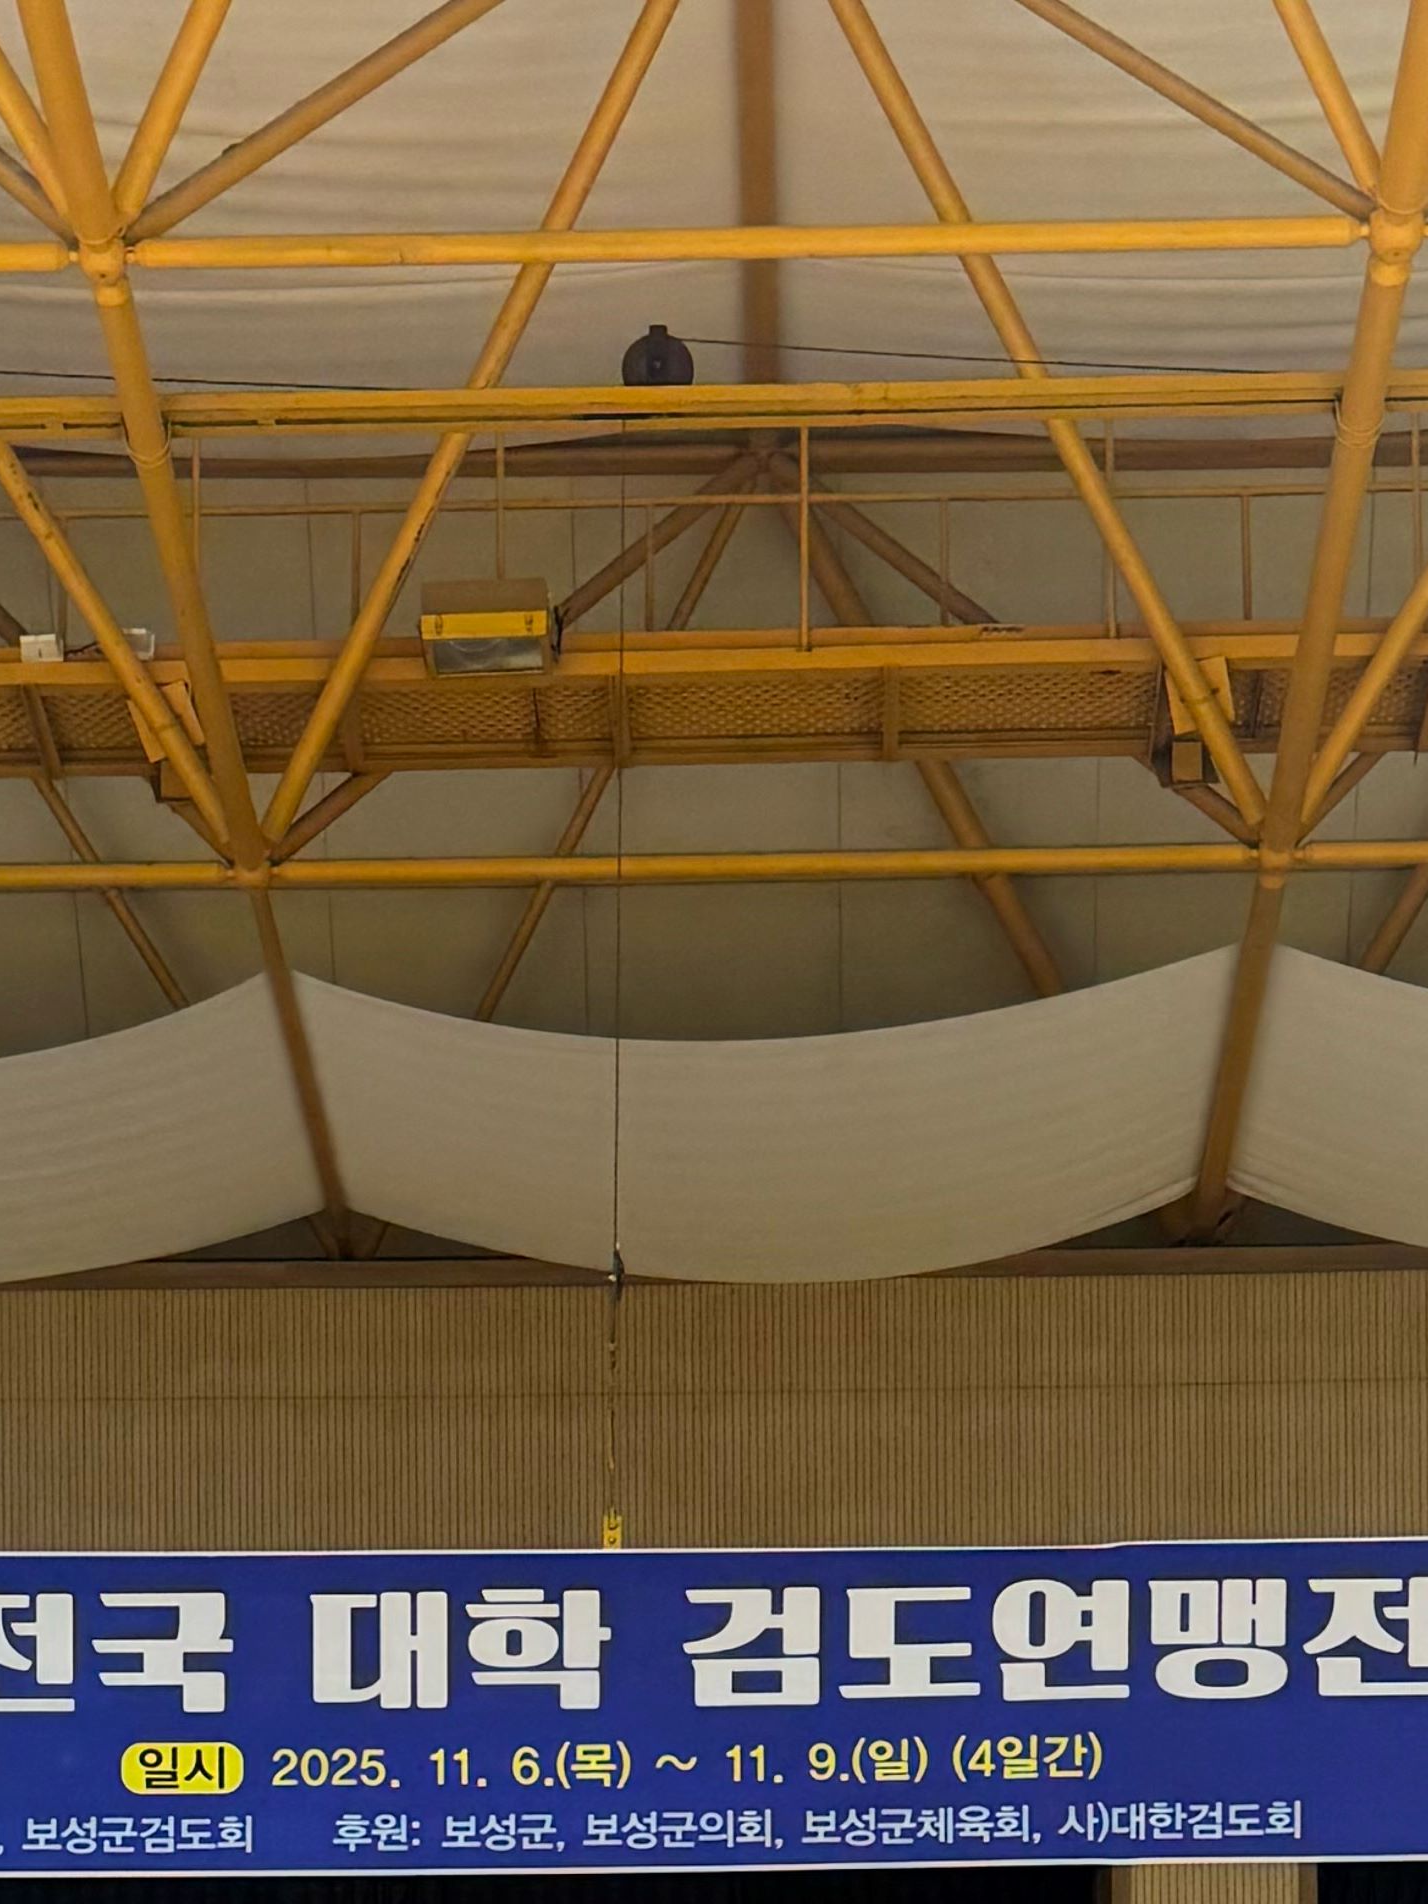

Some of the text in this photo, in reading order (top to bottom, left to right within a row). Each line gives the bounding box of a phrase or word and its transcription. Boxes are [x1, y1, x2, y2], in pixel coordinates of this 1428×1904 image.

[309, 1588, 612, 1710] 대학
[138, 1746, 225, 1789] 일시
[269, 1748, 400, 1788] 2025.
[429, 1748, 487, 1787] 11.
[512, 1740, 631, 1789] 6.(목)
[726, 1744, 783, 1783] 11.
[808, 1739, 928, 1784] 9.(일)
[952, 1739, 1102, 1782] (4일간)
[22, 1815, 252, 1854] 보성군검도회
[333, 1802, 1303, 1852] 후원: 보성군, 보성군의회, 보성군체육회, 사)대한검도회
